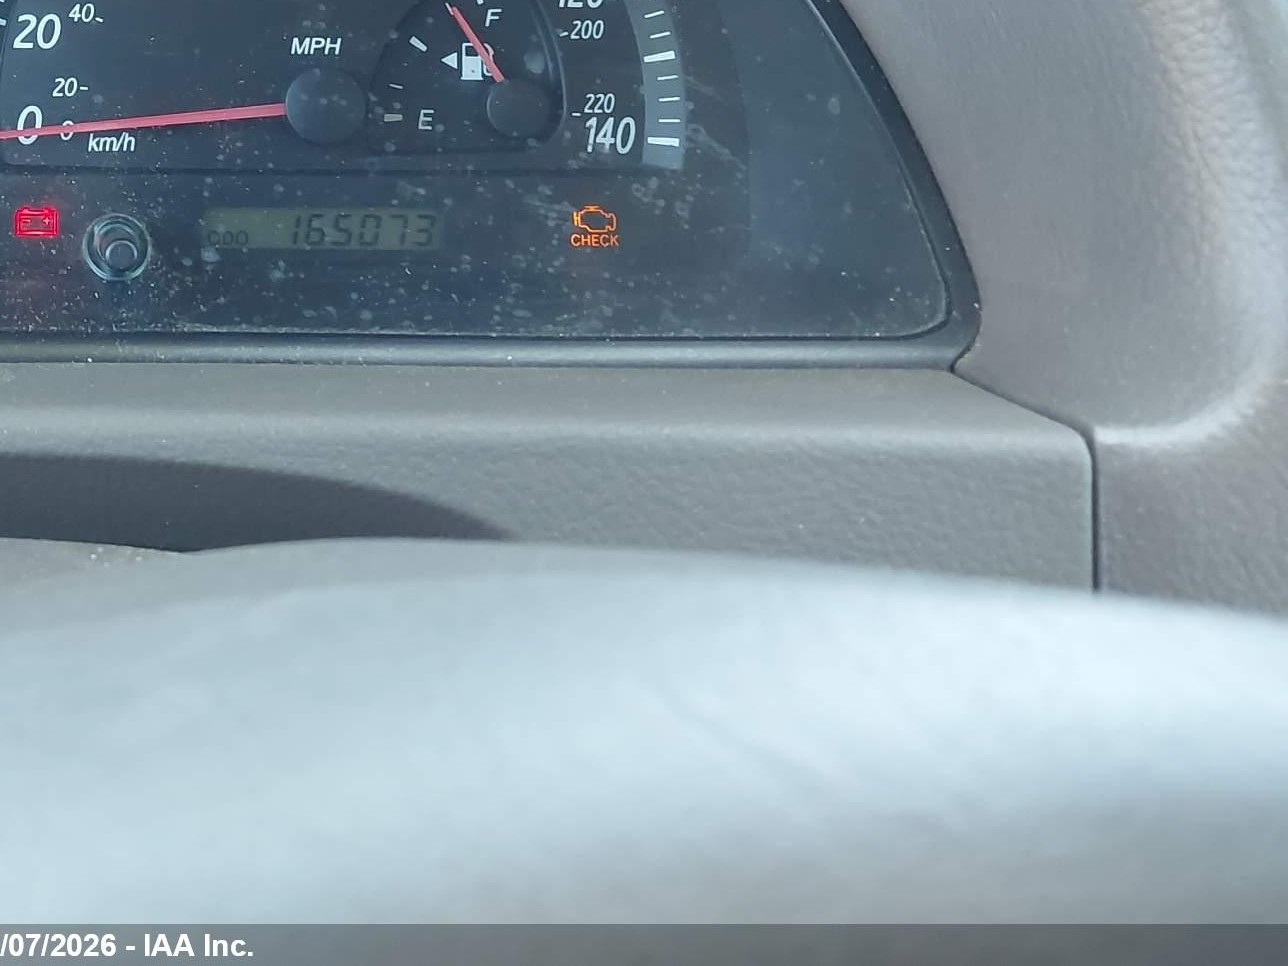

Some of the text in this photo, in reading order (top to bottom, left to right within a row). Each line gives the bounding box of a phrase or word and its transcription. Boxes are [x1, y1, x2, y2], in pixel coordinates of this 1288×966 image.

[68, 3, 95, 22] 40
[484, 8, 502, 26] F
[13, 13, 62, 49] 20
[570, 20, 604, 39] 200
[290, 37, 342, 55] MPH
[52, 77, 77, 97] 20
[584, 94, 615, 113] 220
[17, 105, 43, 145] 0
[418, 110, 434, 130] E
[87, 133, 136, 153] km/h
[585, 117, 636, 154] 140
[292, 214, 436, 246] 165073
[570, 234, 619, 247] CHECK
